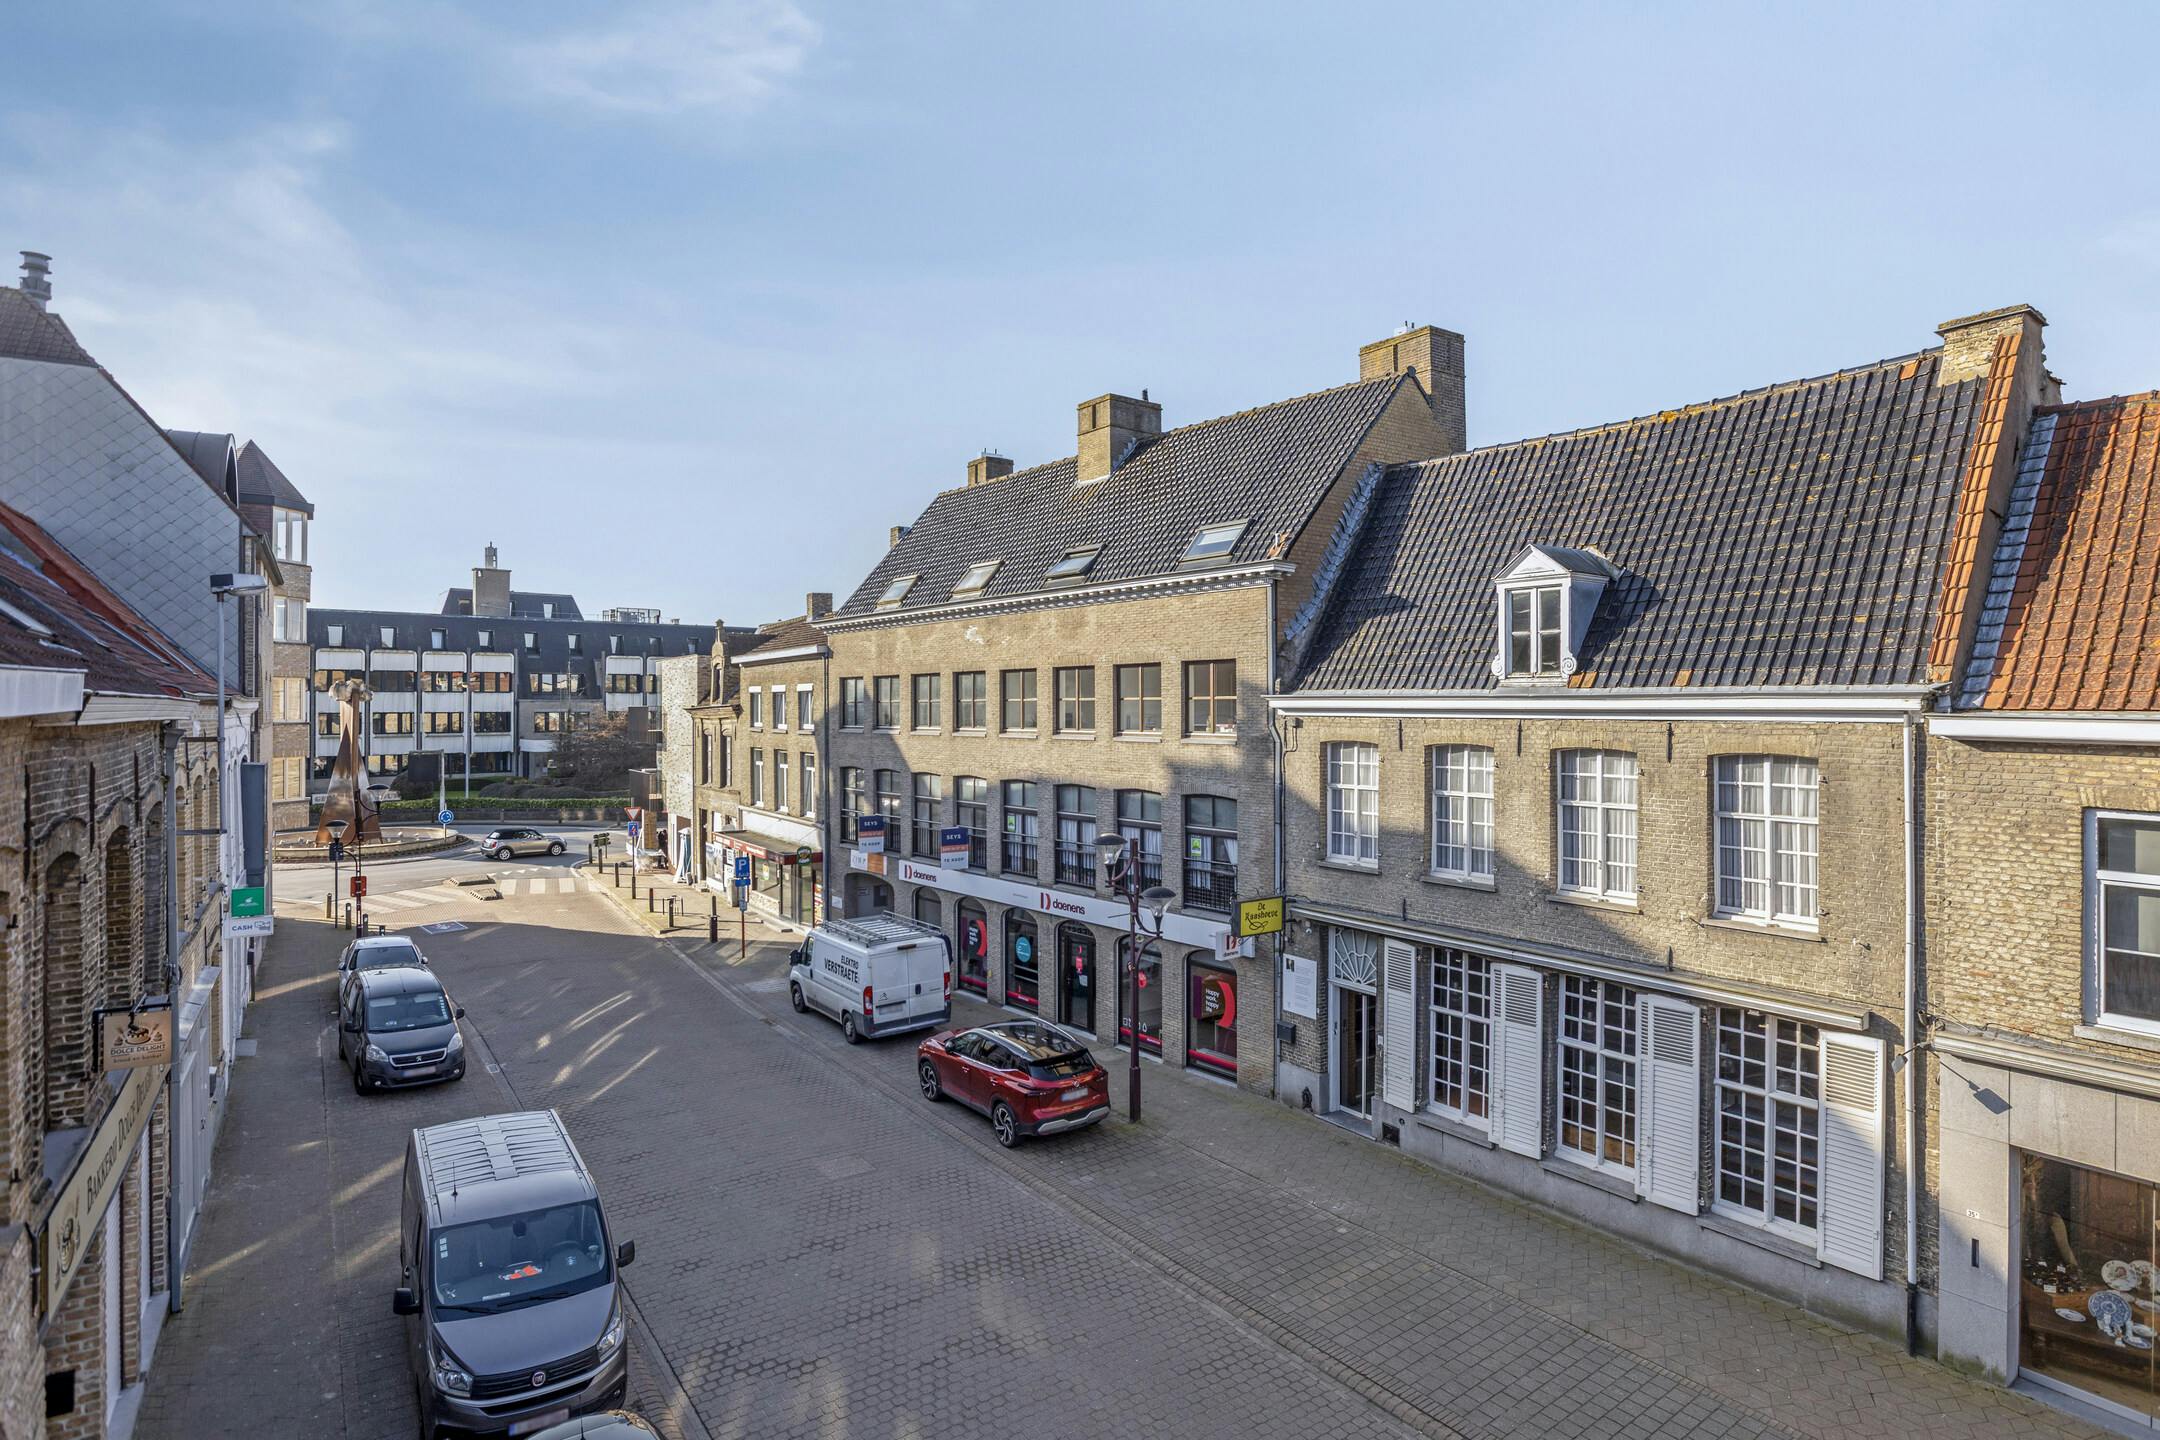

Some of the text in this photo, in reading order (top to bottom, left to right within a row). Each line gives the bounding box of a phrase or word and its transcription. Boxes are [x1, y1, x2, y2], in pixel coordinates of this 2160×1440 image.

[738, 859, 747, 871] P
[913, 868, 937, 882] daenens
[1053, 898, 1086, 915] daenens
[1257, 902, 1266, 911] De
[840, 954, 859, 970] ELEKTRO
[823, 957, 859, 984] VERSTRAETE
[110, 1043, 166, 1056] DOLCE DELIGHT
